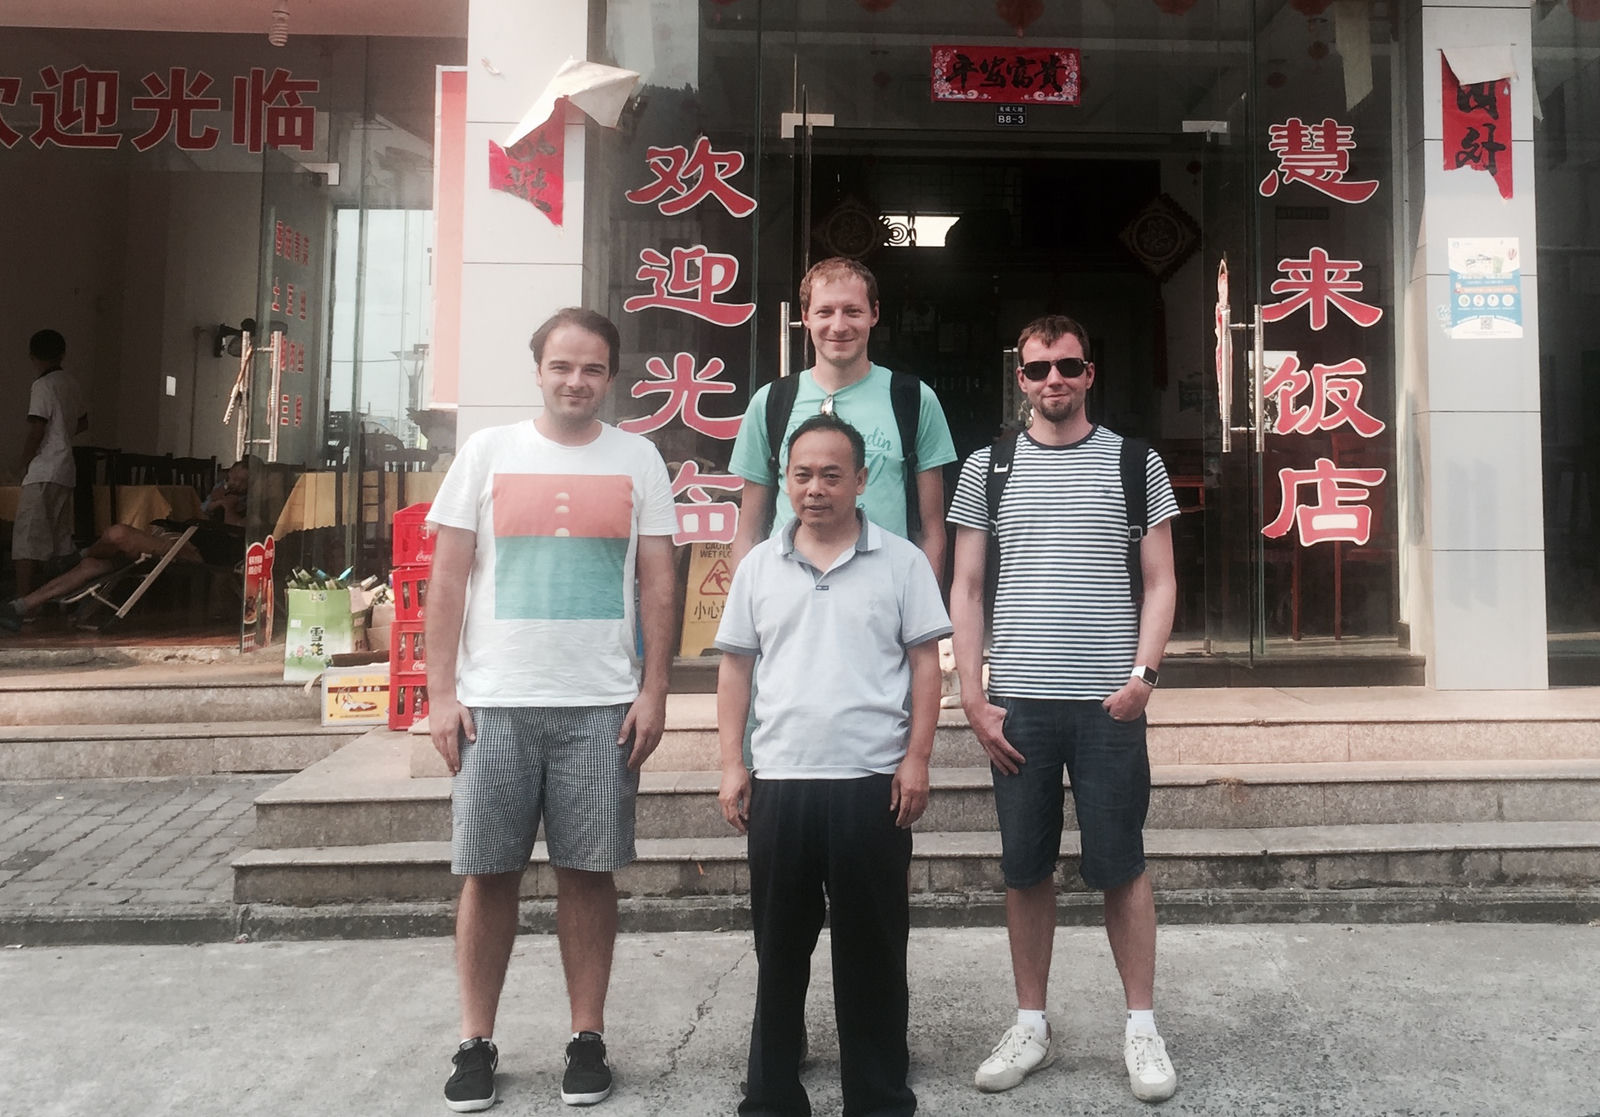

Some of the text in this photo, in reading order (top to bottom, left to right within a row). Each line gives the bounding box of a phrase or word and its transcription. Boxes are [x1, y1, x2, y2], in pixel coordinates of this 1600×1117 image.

[0, 64, 320, 153] 迎光临
[998, 115, 1024, 124] B8-3
[1259, 117, 1387, 548] 慧来饭店
[700, 550, 717, 558] WET
[310, 626, 324, 657] 雪花
